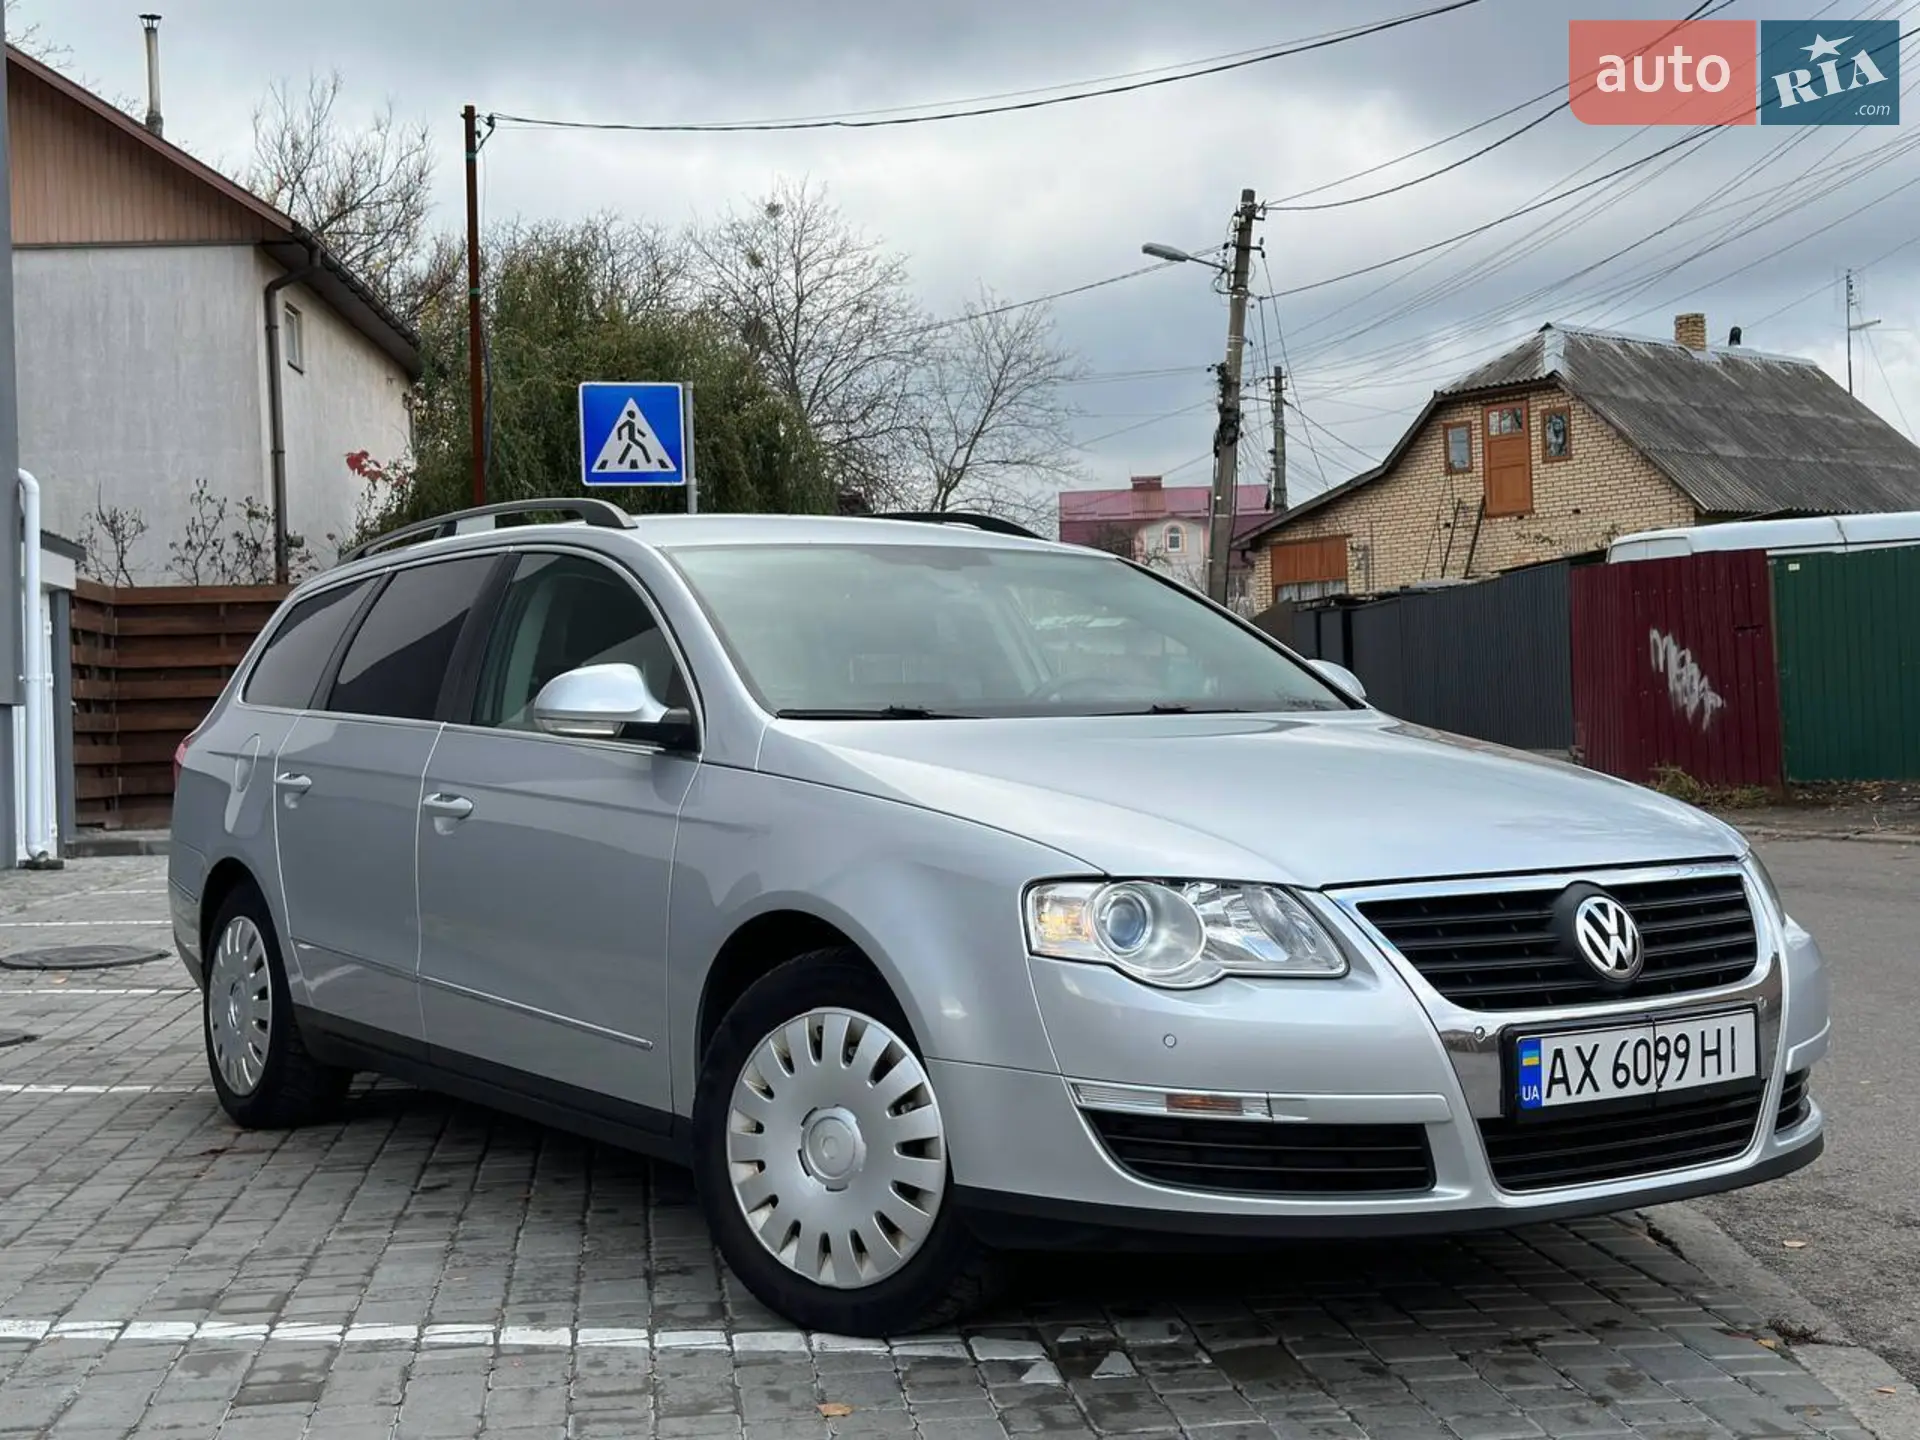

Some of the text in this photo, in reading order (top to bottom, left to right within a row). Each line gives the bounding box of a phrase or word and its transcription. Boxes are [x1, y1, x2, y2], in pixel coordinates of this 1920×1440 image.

[1546, 1026, 1735, 1098] AX 6099 HI
[1522, 1086, 1540, 1101] UA
